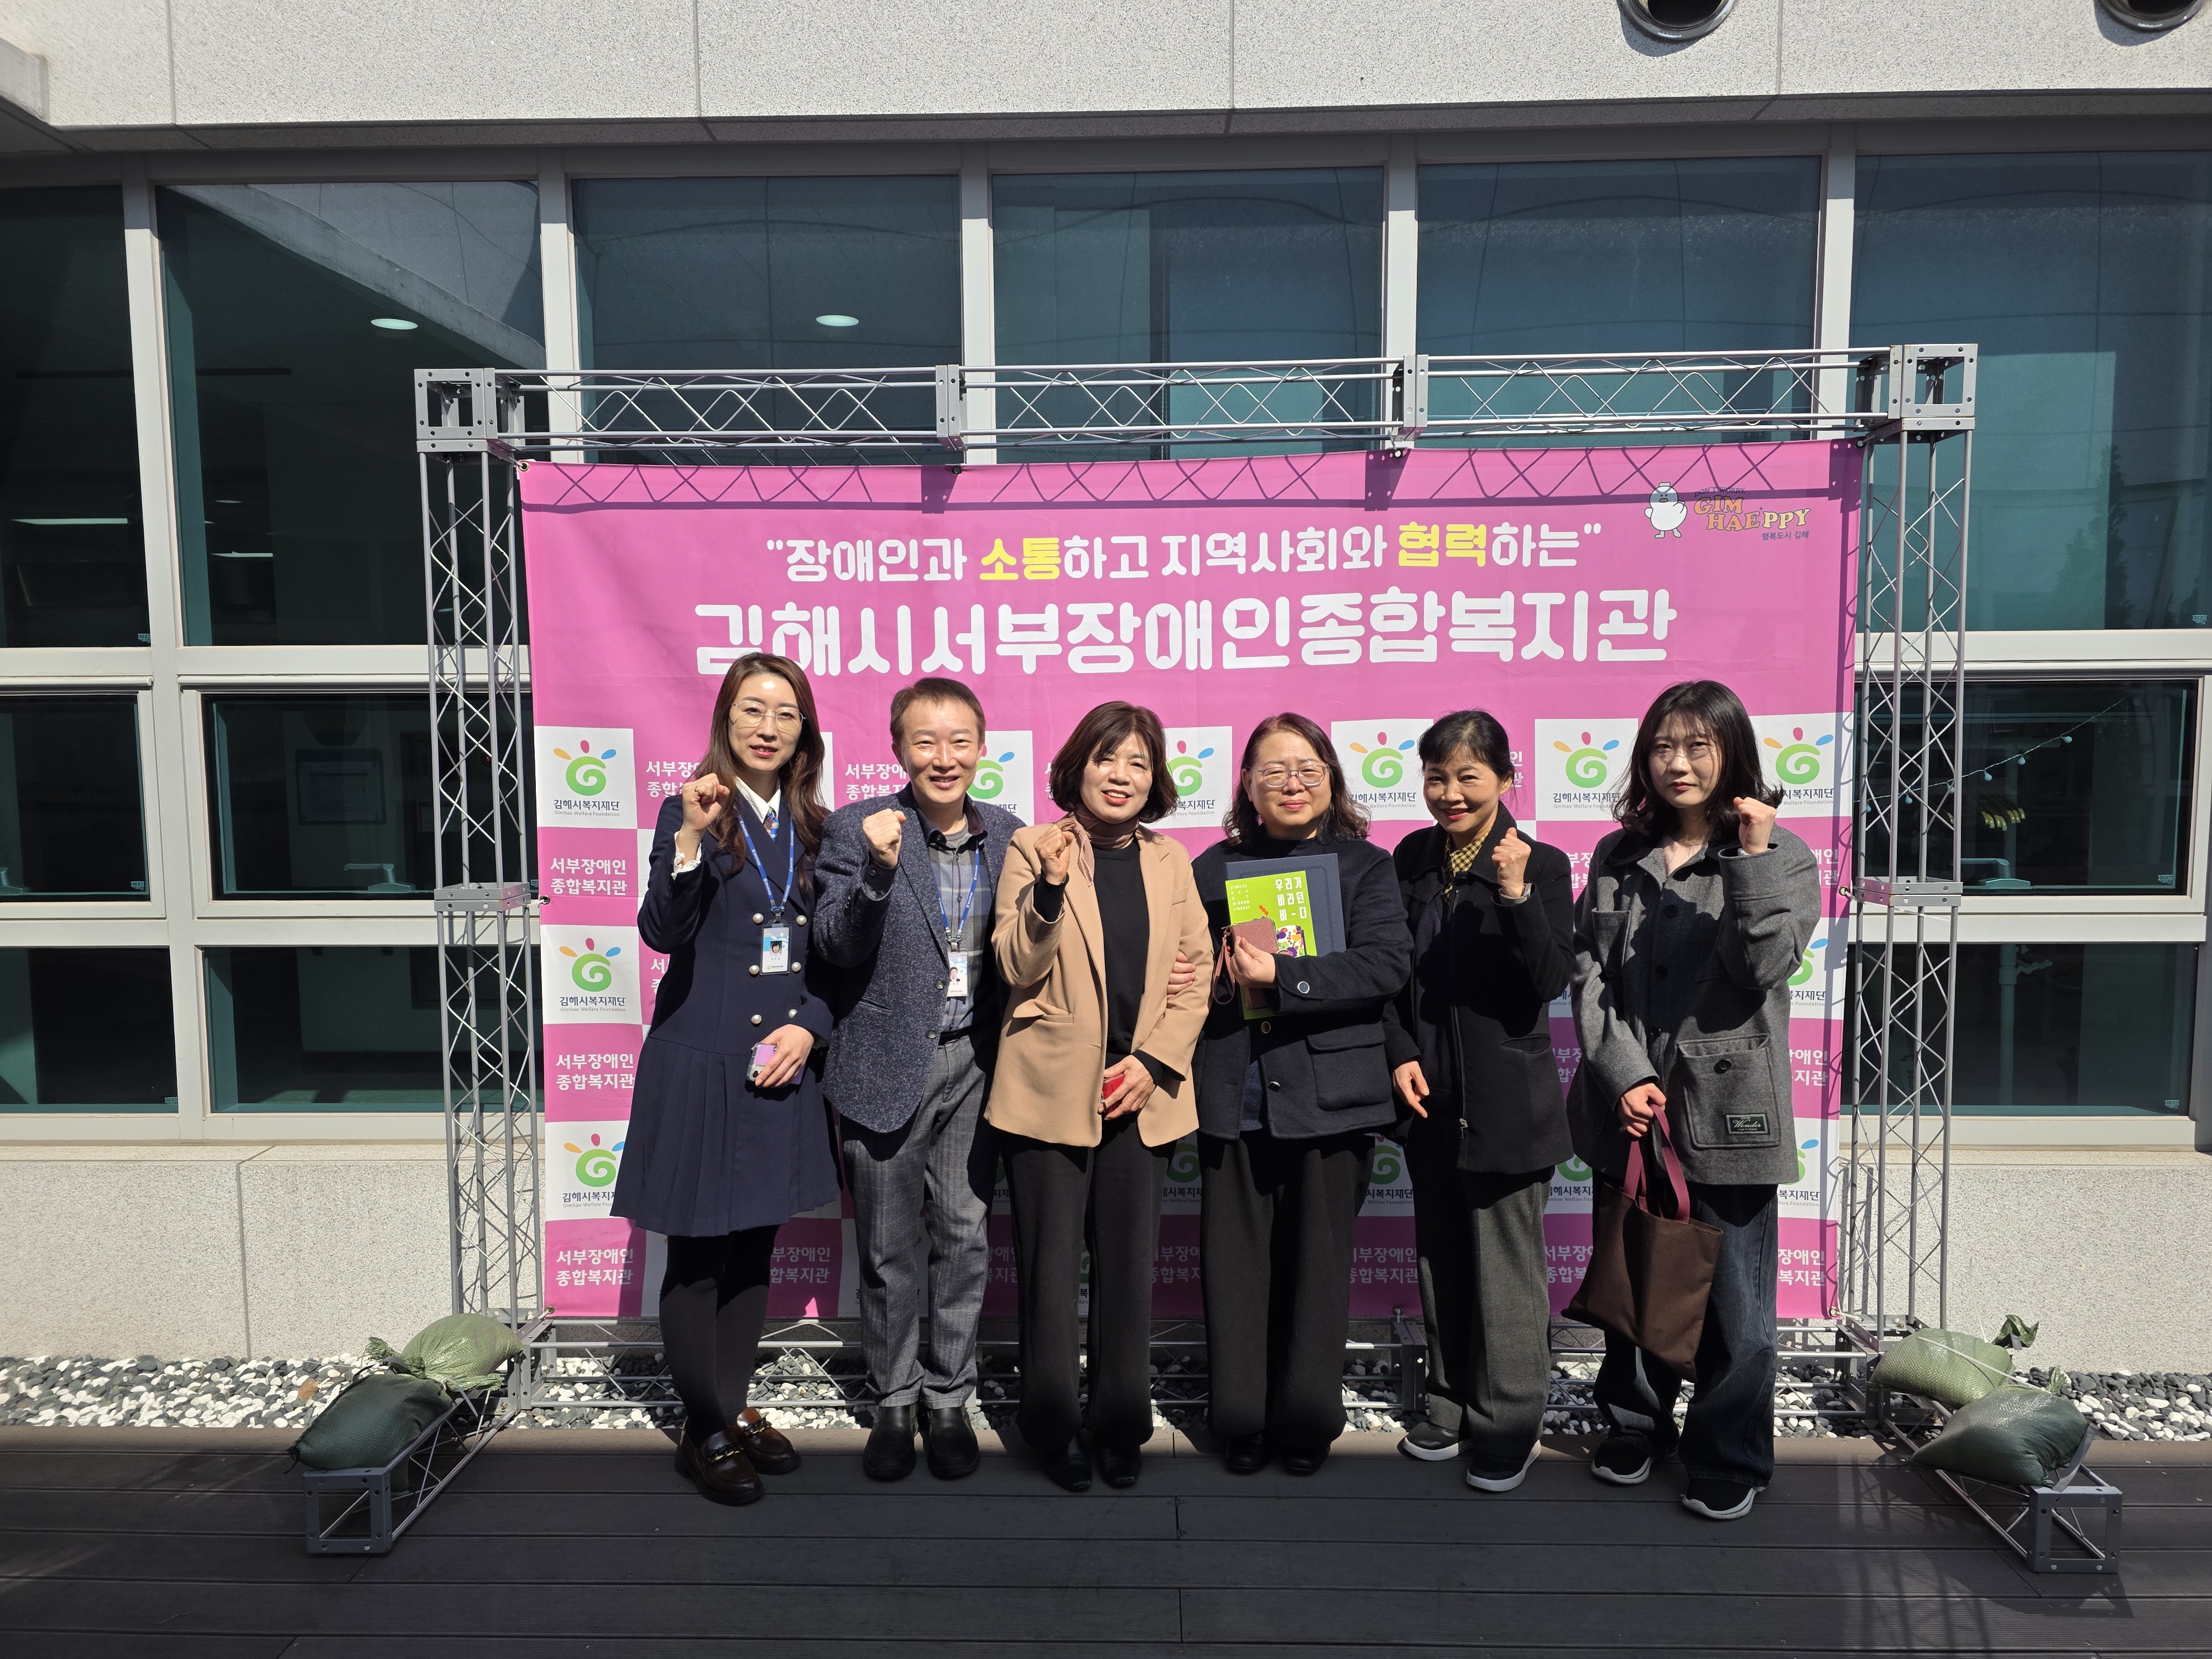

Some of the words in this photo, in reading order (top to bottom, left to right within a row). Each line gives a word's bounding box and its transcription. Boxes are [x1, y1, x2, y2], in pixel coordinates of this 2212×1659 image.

[1694, 487, 1718, 498] DON'T
[1694, 495, 1744, 515] GIM
[1762, 531, 1791, 540] 행복도시
[1794, 530, 1809, 539] 김해
[979, 535, 1149, 581] 소통하고
[1161, 524, 1387, 576] 지역사회와
[695, 586, 1677, 676] 김해시서부장애인종합복지관
[646, 761, 700, 778] 서부장
[554, 800, 620, 811] 김해시복지재단
[550, 858, 627, 875] 서부장애인
[551, 878, 627, 895] 종합복지관
[1275, 877, 1302, 891] 우리가
[1277, 891, 1305, 906] 바라던
[560, 997, 625, 1006] 김해시복지재단
[556, 1053, 634, 1070] 서부장애인
[556, 1073, 635, 1091] 종합복지관
[1733, 1119, 1761, 1128] Wonder
[556, 1249, 633, 1266] 서부장애인
[556, 1269, 633, 1287] 종합복지관
